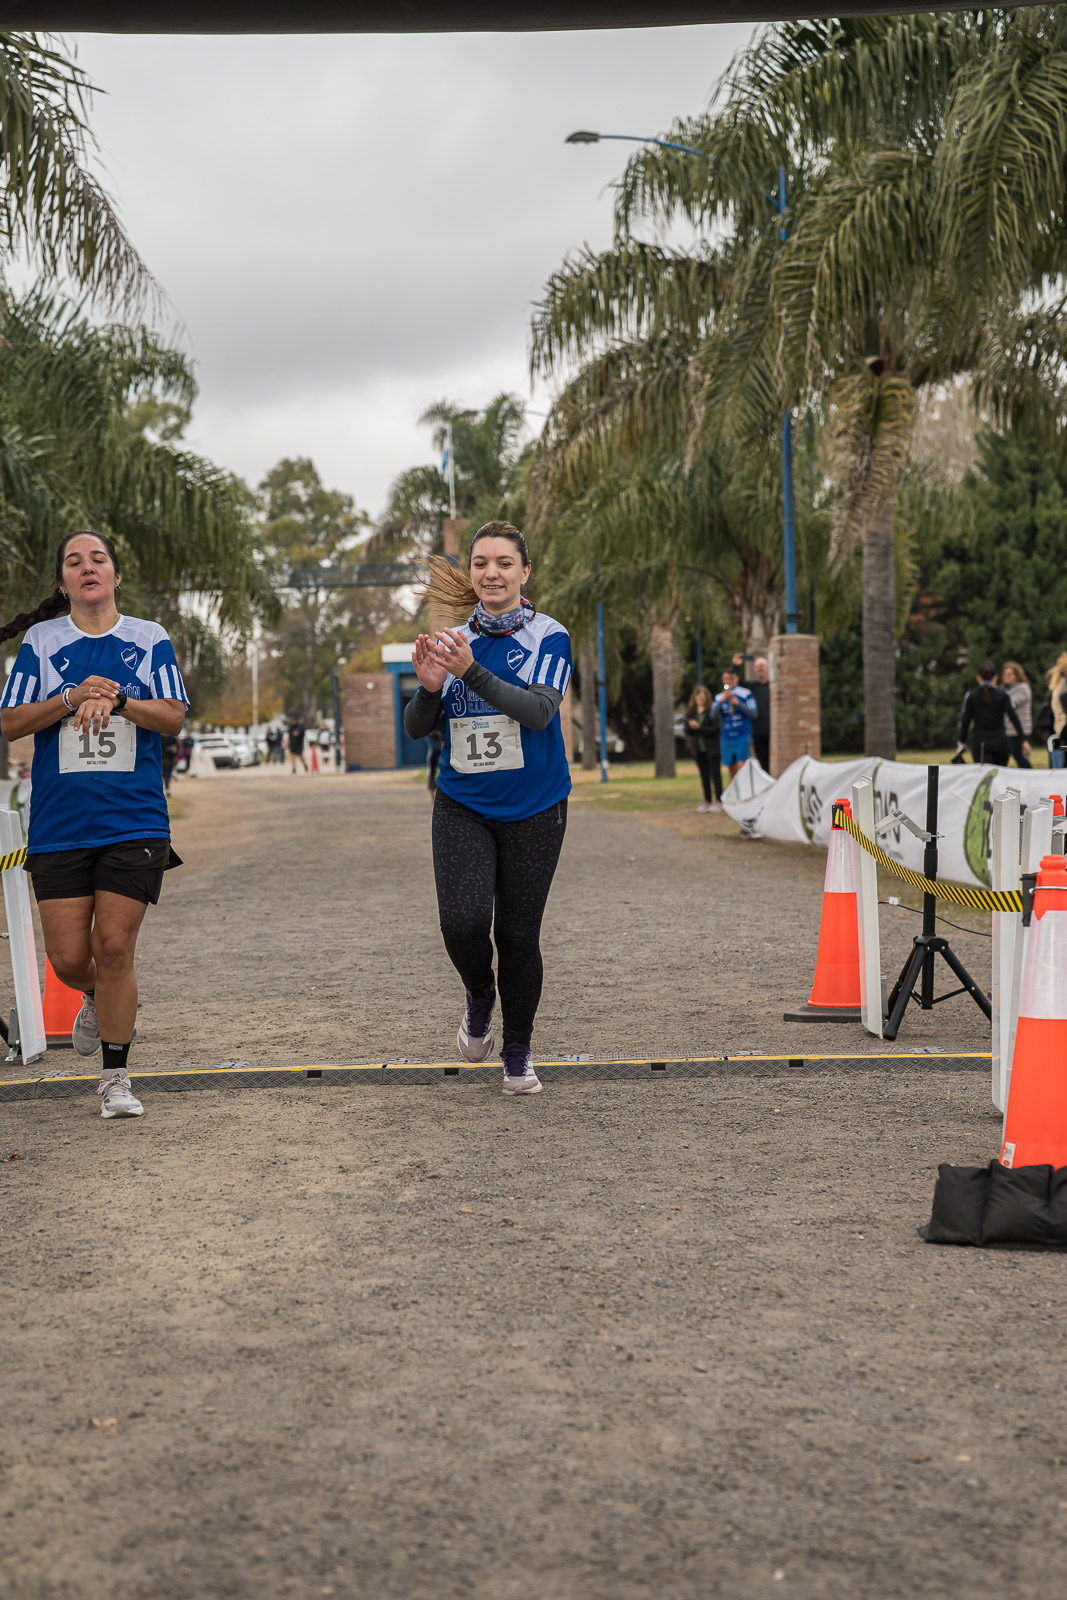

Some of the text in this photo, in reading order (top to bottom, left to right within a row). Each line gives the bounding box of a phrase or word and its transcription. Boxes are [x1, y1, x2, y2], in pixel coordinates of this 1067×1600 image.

[452, 679, 467, 717] 3
[79, 732, 117, 758] 15
[466, 732, 502, 760] 13
